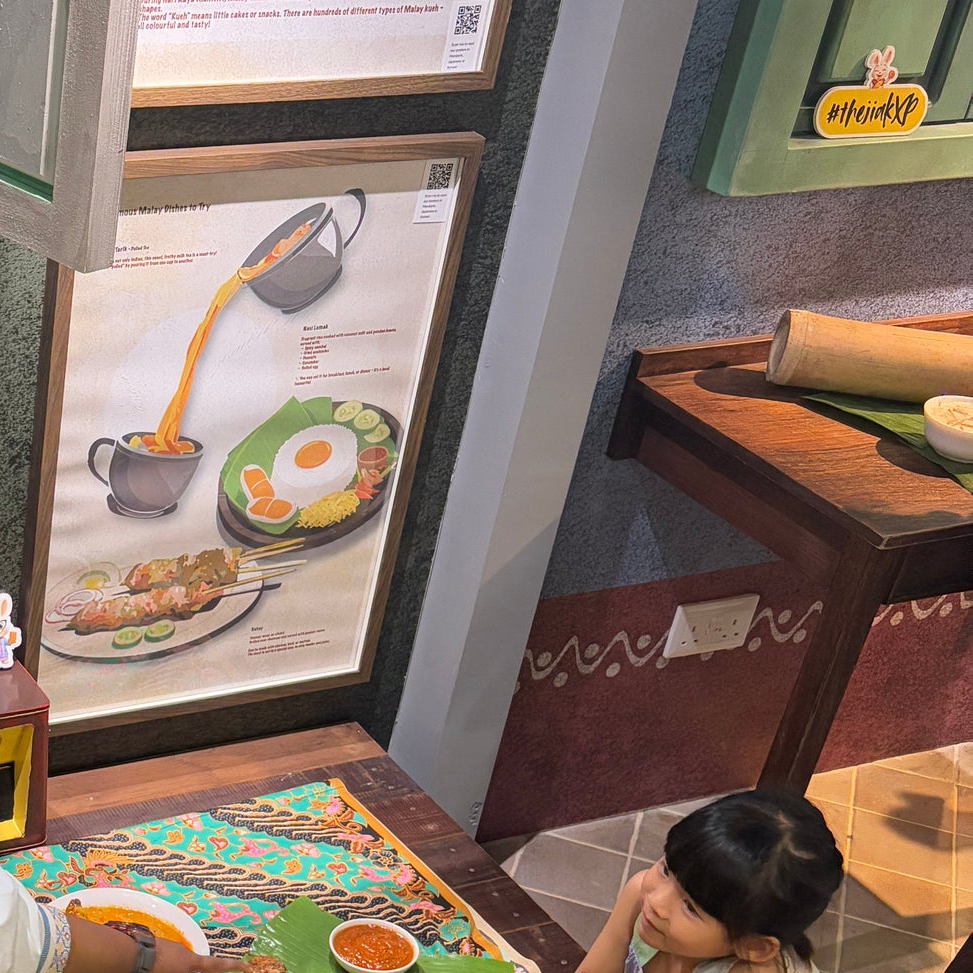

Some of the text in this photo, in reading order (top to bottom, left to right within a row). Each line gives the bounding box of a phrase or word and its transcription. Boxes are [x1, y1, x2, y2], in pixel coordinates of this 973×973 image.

[140, 6, 162, 14] hapes.
[150, 12, 166, 20] word
[214, 10, 229, 18] little
[258, 10, 282, 18] snacks.
[284, 9, 300, 17] There
[313, 8, 342, 16] hundreds
[350, 6, 378, 15] different
[379, 7, 396, 16] types
[396, 6, 404, 14] of
[404, 5, 424, 14] Malay
[424, 4, 439, 12] kueh
[146, 20, 176, 30] colourful
[177, 20, 190, 28] and
[191, 20, 211, 29] tasty!
[138, 206, 163, 216] Malay
[164, 204, 188, 213] Dishes
[190, 203, 196, 212] to
[199, 202, 212, 212] Try
